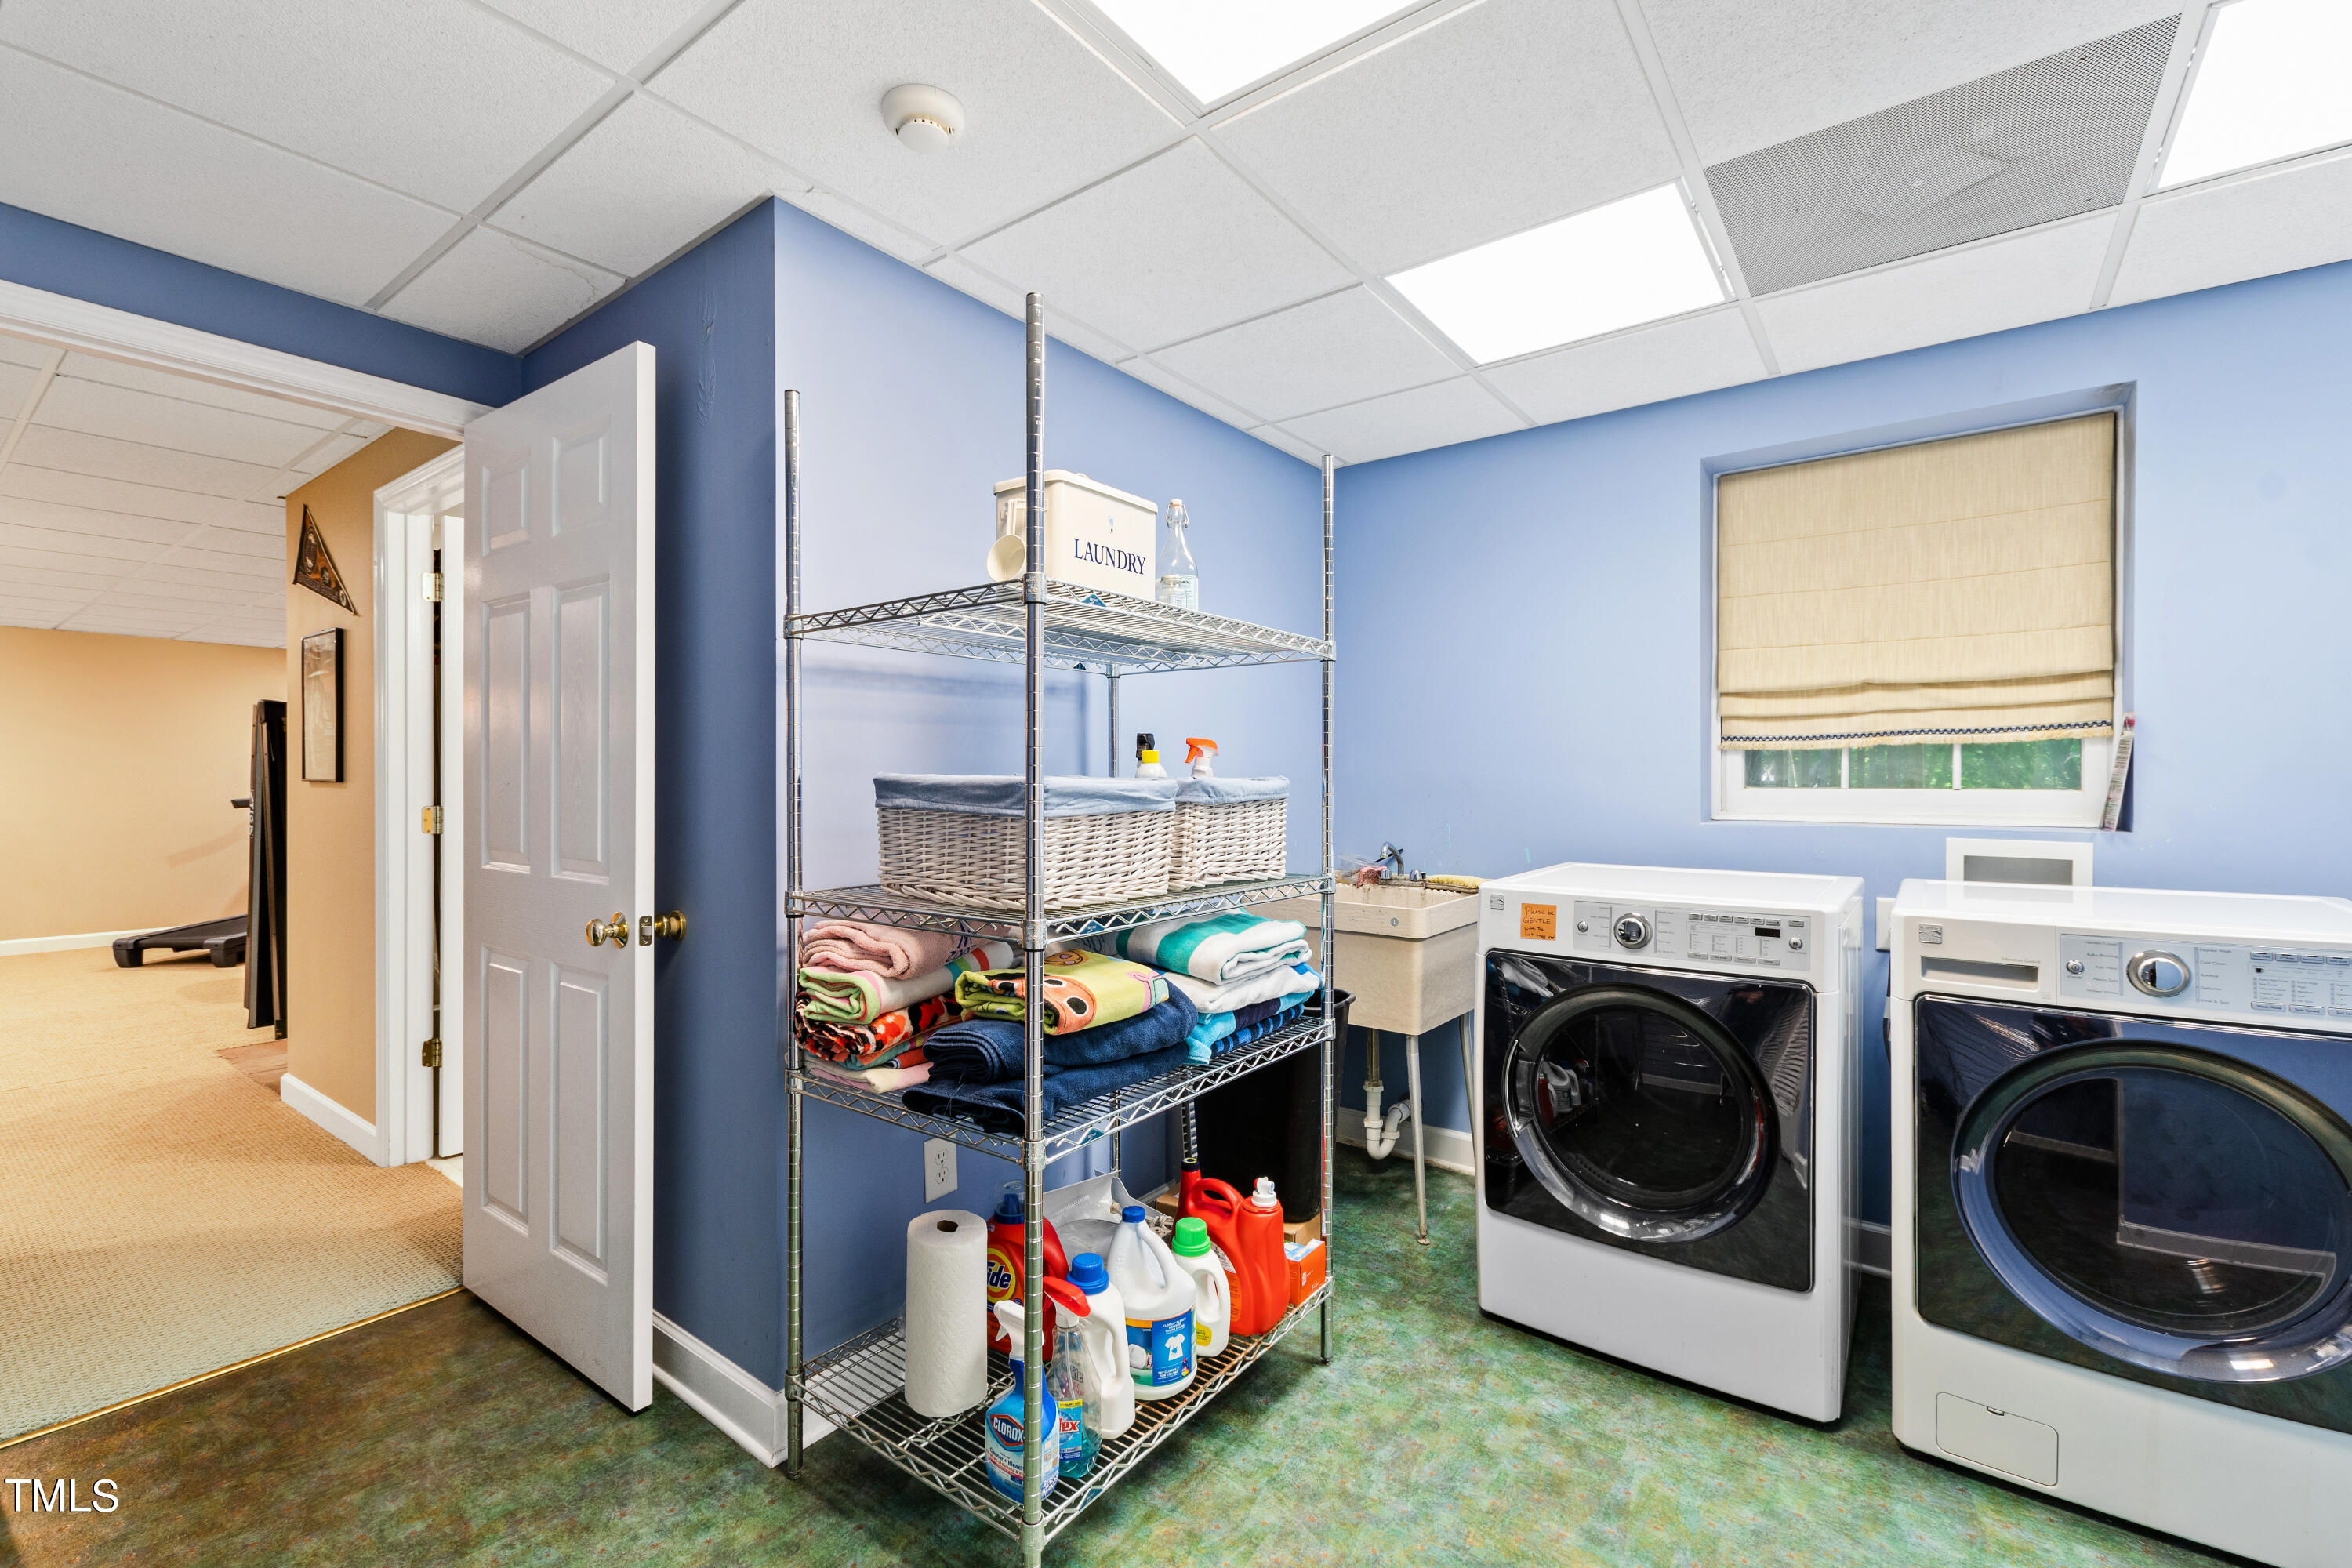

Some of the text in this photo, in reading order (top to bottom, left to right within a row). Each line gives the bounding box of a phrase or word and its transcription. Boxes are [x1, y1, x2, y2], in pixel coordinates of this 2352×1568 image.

[1073, 538, 1147, 575] LAUNDRY
[1524, 905, 1545, 916] Please
[1523, 916, 1551, 925] GENTLE
[993, 1416, 1024, 1443] CLOROX
[989, 1447, 1004, 1461] Cleaner
